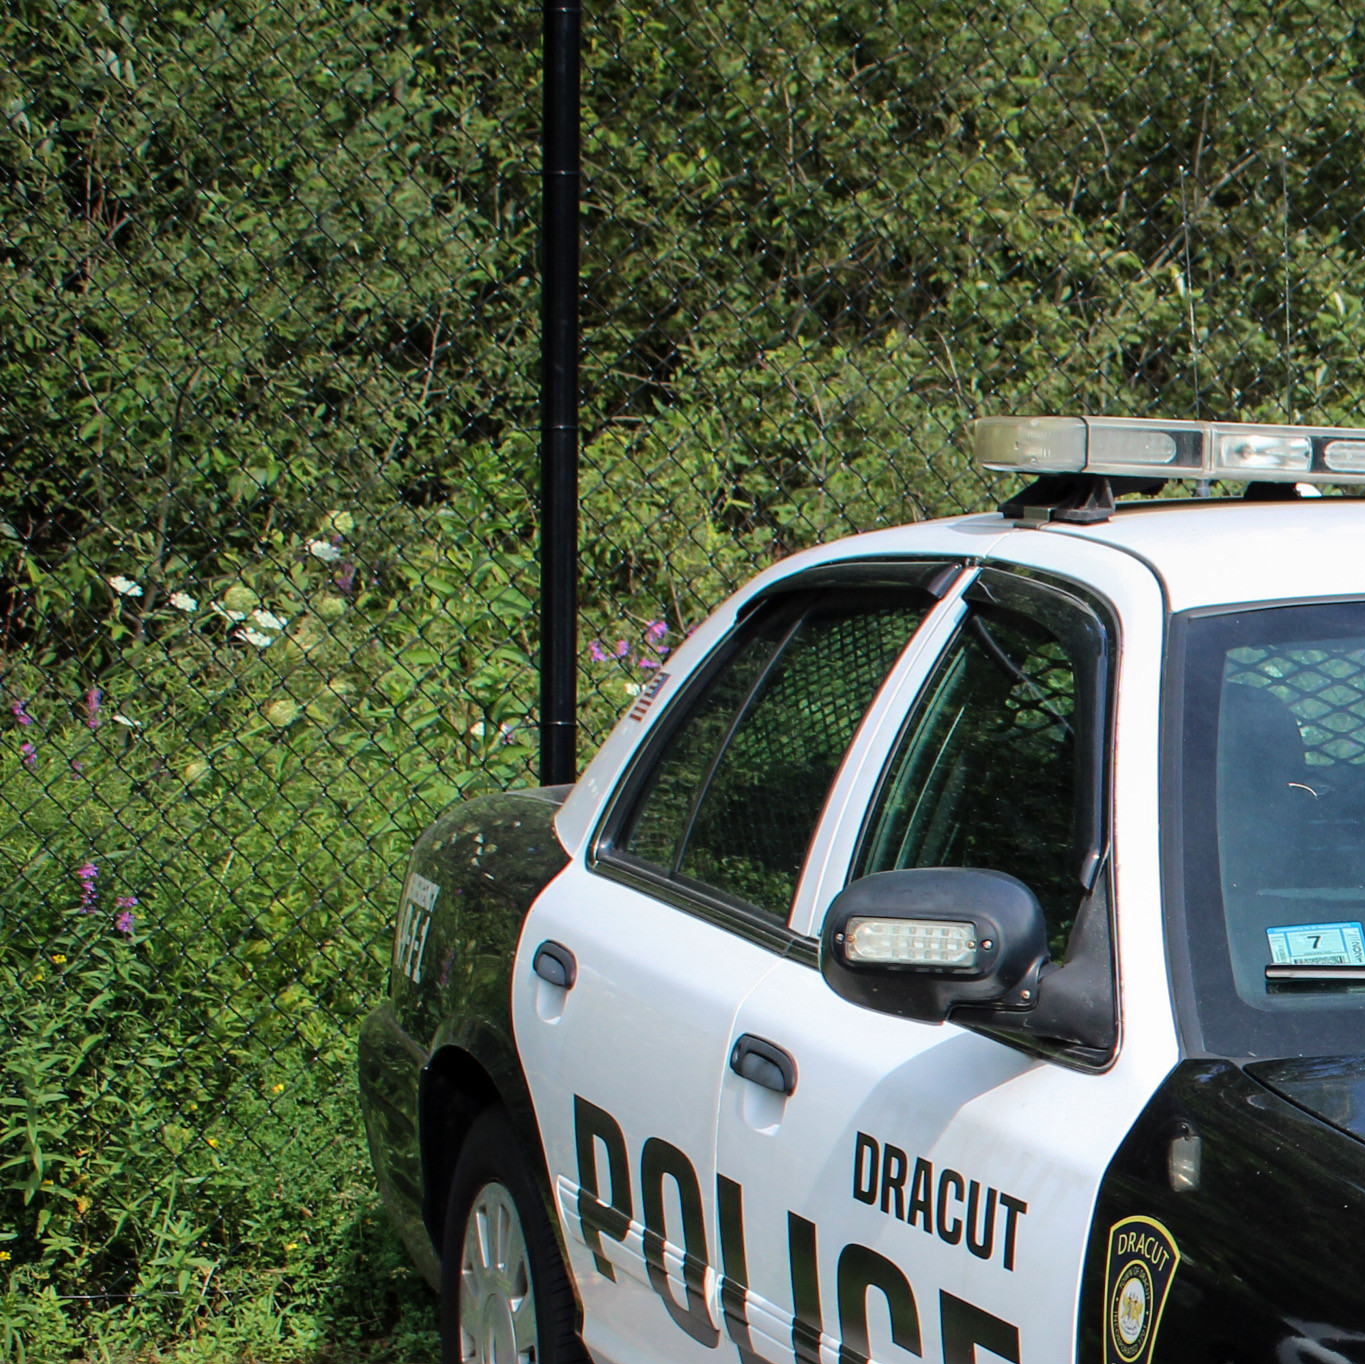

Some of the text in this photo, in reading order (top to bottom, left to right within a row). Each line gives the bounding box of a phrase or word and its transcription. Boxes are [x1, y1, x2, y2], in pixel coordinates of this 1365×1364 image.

[1307, 935, 1321, 949] 7
[853, 1130, 1028, 1271] DRACUT
[1118, 1232, 1169, 1271] DRACUT
